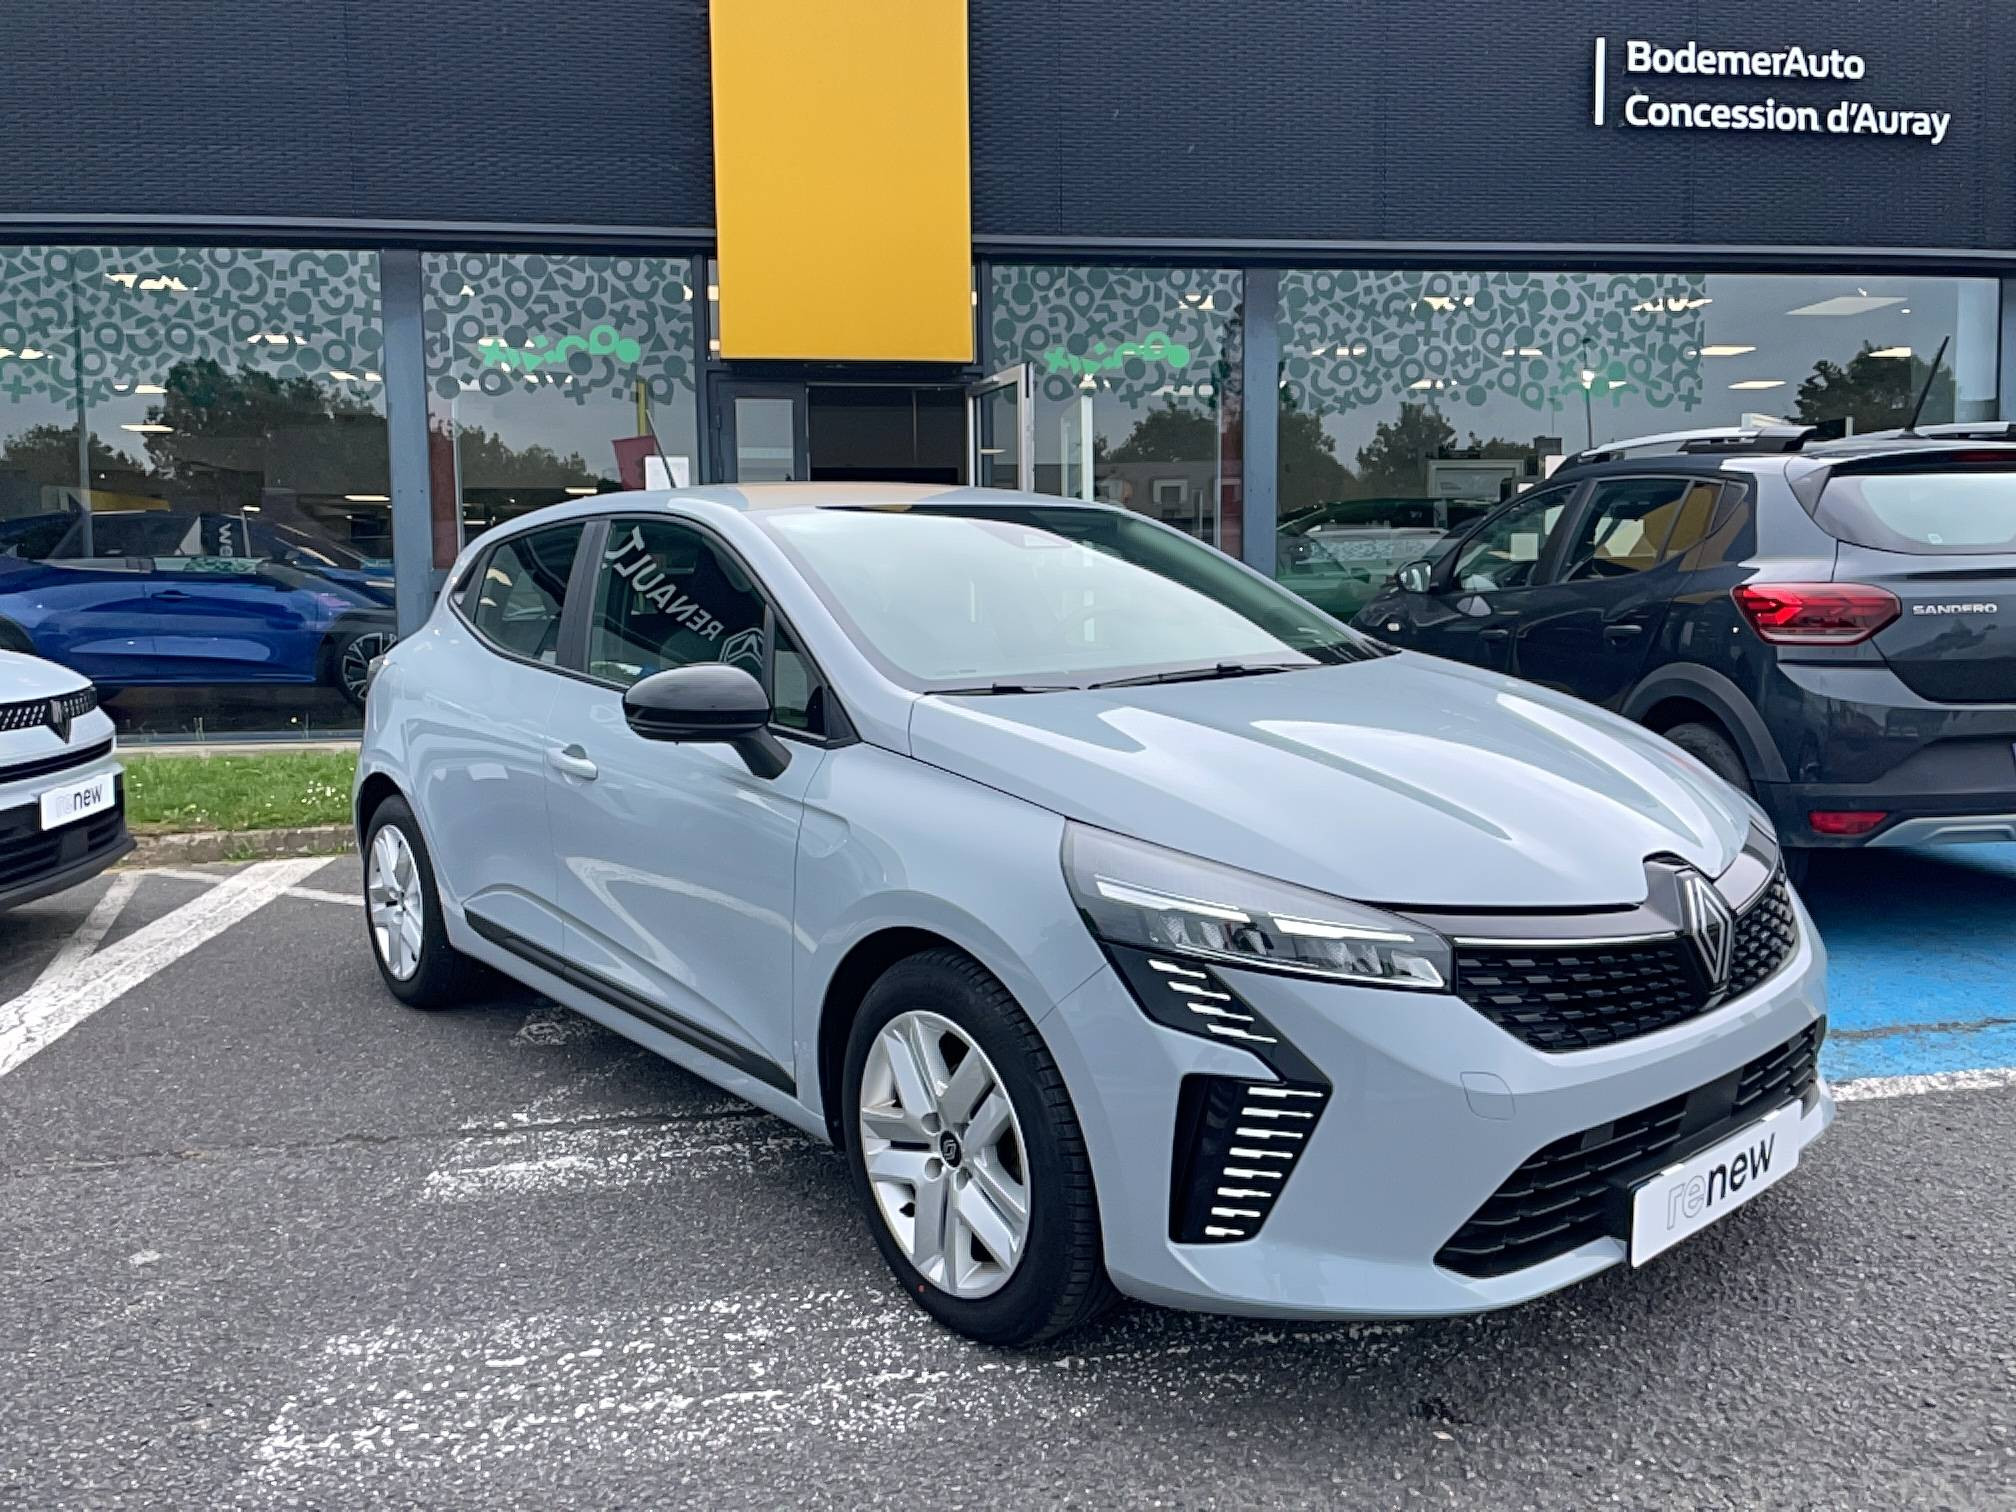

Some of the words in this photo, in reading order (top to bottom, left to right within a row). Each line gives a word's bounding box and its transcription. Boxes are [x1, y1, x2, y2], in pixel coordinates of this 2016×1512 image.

[1626, 40, 1865, 79] BodemerAuto
[1625, 95, 1819, 130] Concession
[1827, 101, 1951, 144] d'Auray
[1912, 603, 1998, 615] SANDERO
[1667, 1133, 1775, 1230] renew
